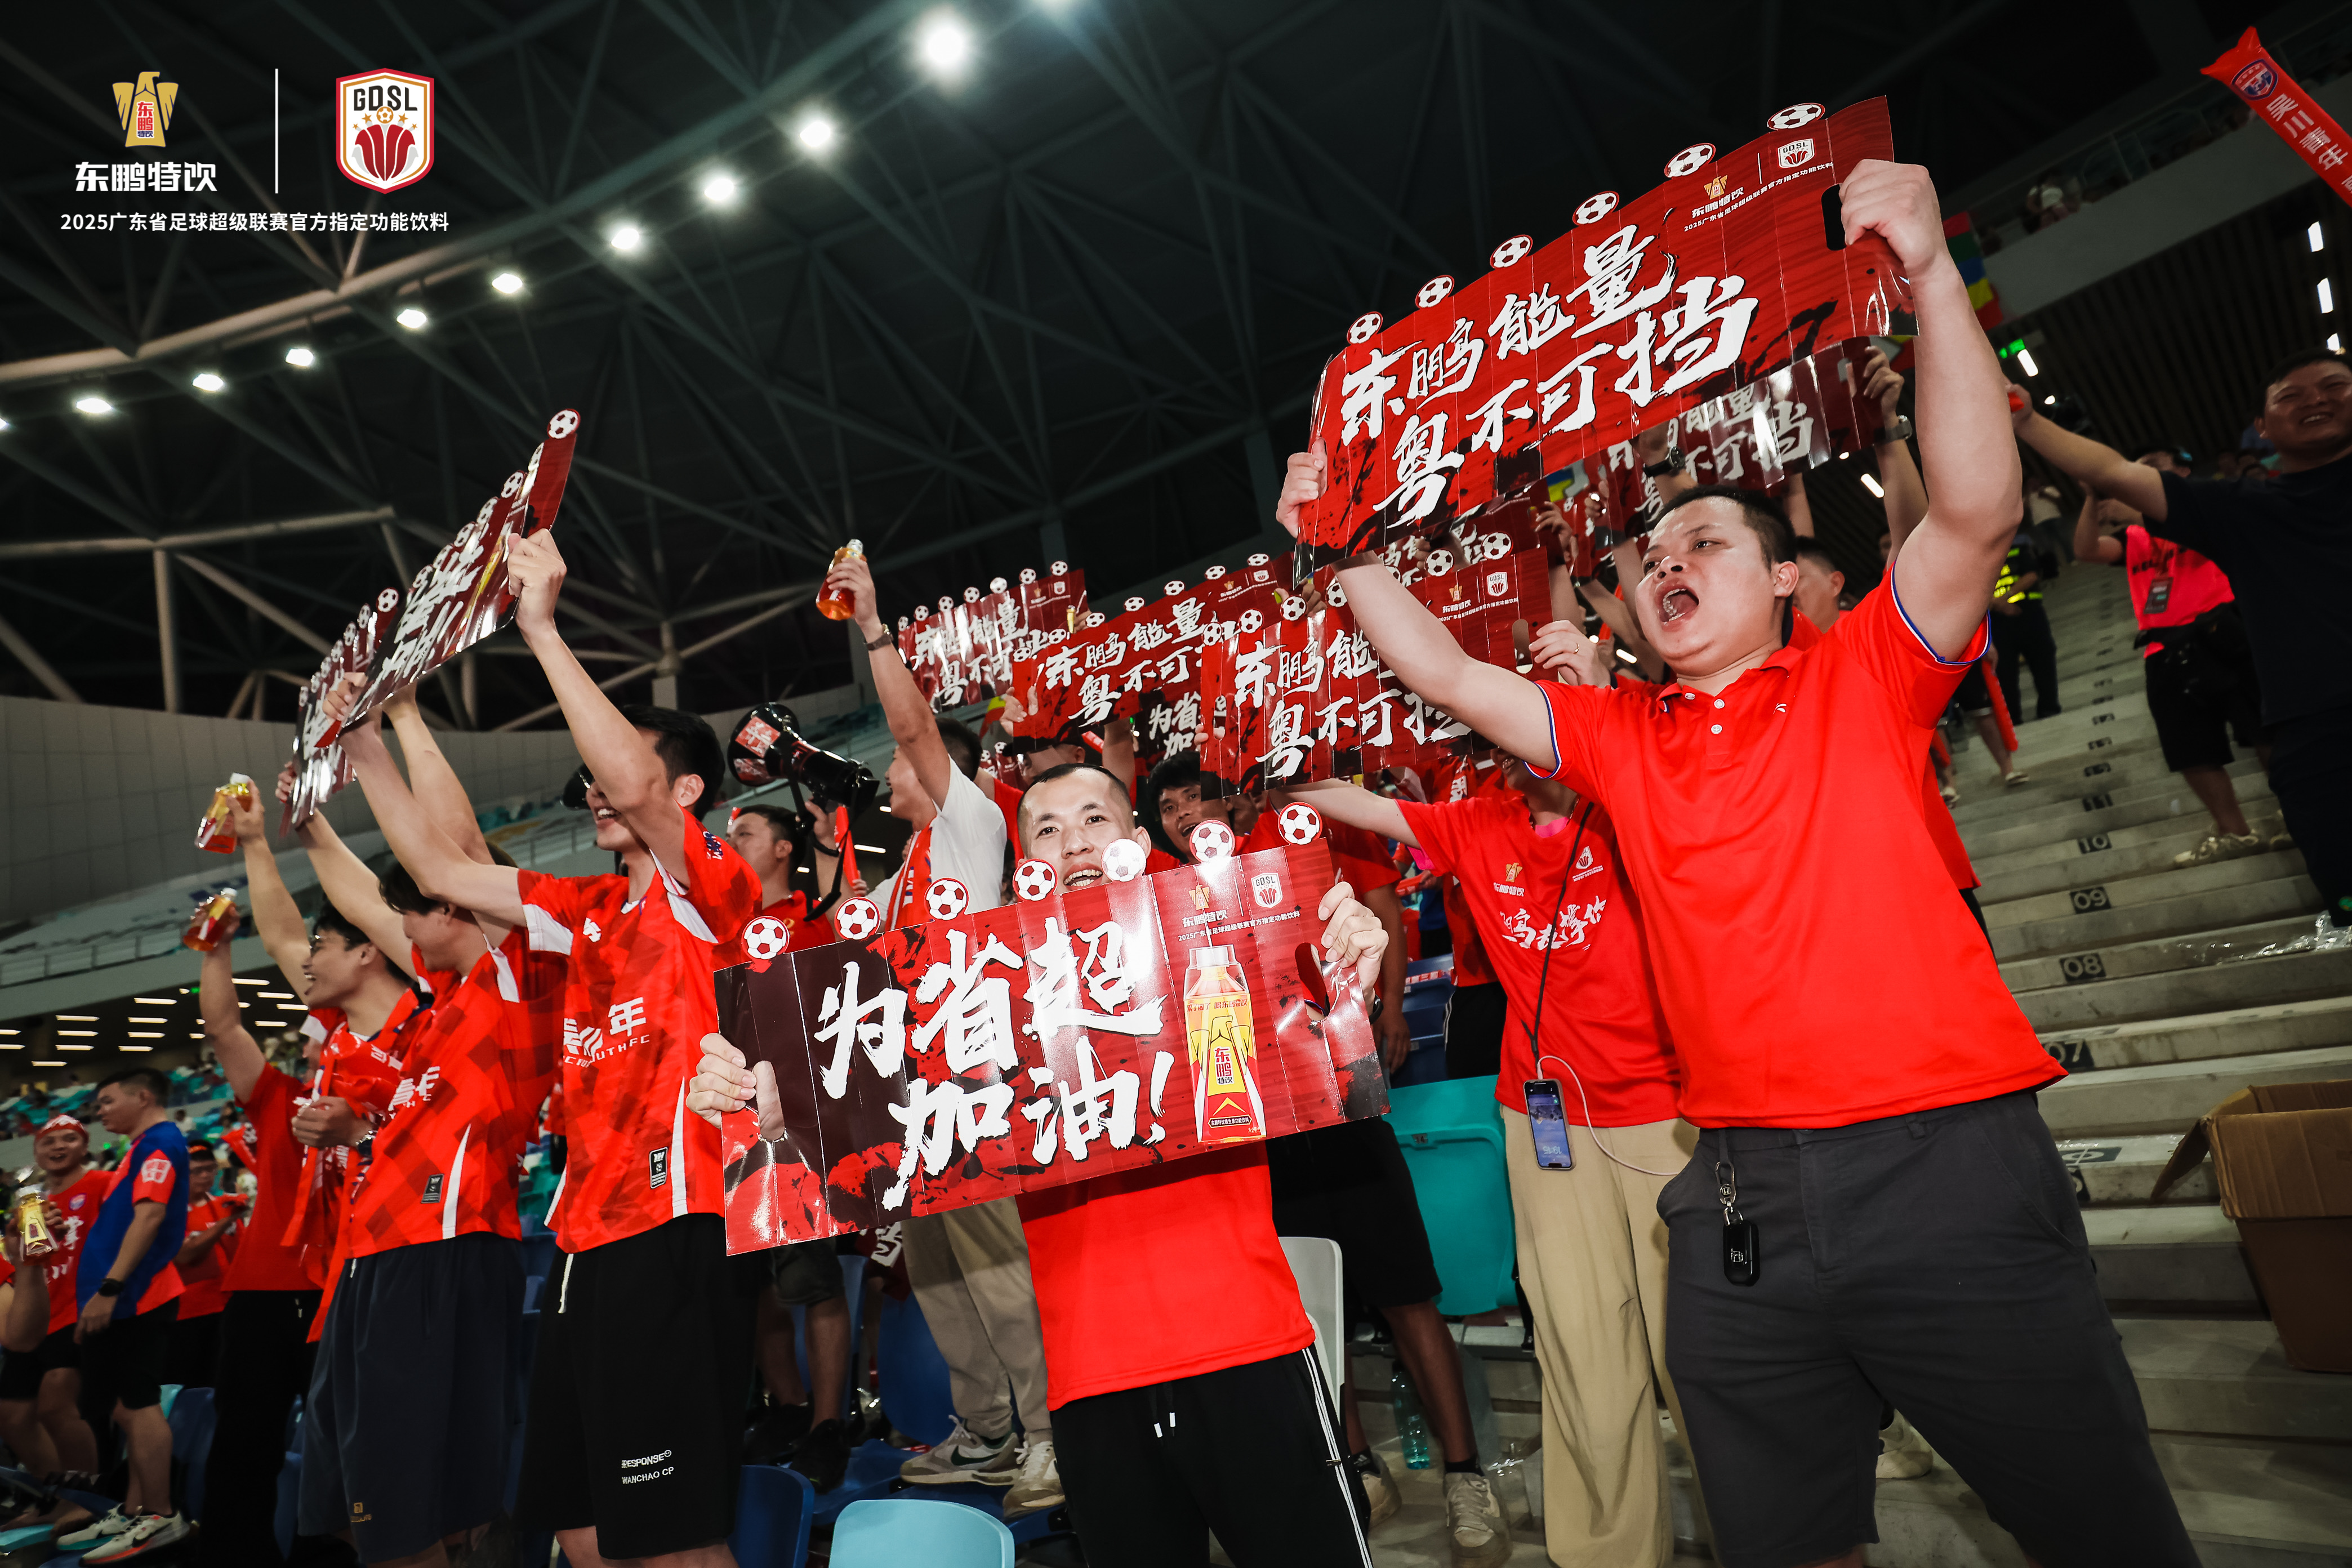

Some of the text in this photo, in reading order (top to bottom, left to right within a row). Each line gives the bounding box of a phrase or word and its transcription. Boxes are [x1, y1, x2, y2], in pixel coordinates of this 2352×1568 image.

[1783, 142, 1808, 154] GDSL
[1691, 186, 1745, 219] 东鹏特饮
[1340, 224, 1676, 446] 东鹏能量
[1373, 275, 1758, 527] 粤不可挡
[1046, 596, 1218, 691] 东鹏能量
[1235, 629, 1397, 709] 东鹏能
[1148, 691, 1201, 741] 为省
[2082, 834, 2108, 853] 10
[1255, 876, 1276, 887] GDSL
[2074, 888, 2106, 910] 09
[1182, 909, 1228, 928] 东鹏特饮
[2064, 954, 2102, 978] 08
[814, 916, 1169, 1100] 为省超
[1214, 1047, 1232, 1078] 东鹏
[1217, 1076, 1234, 1085] 特饮
[881, 1035, 1176, 1212] 加油!
[621, 1453, 665, 1468] RESPONSE
[621, 1466, 674, 1485] WANCHAO CP
